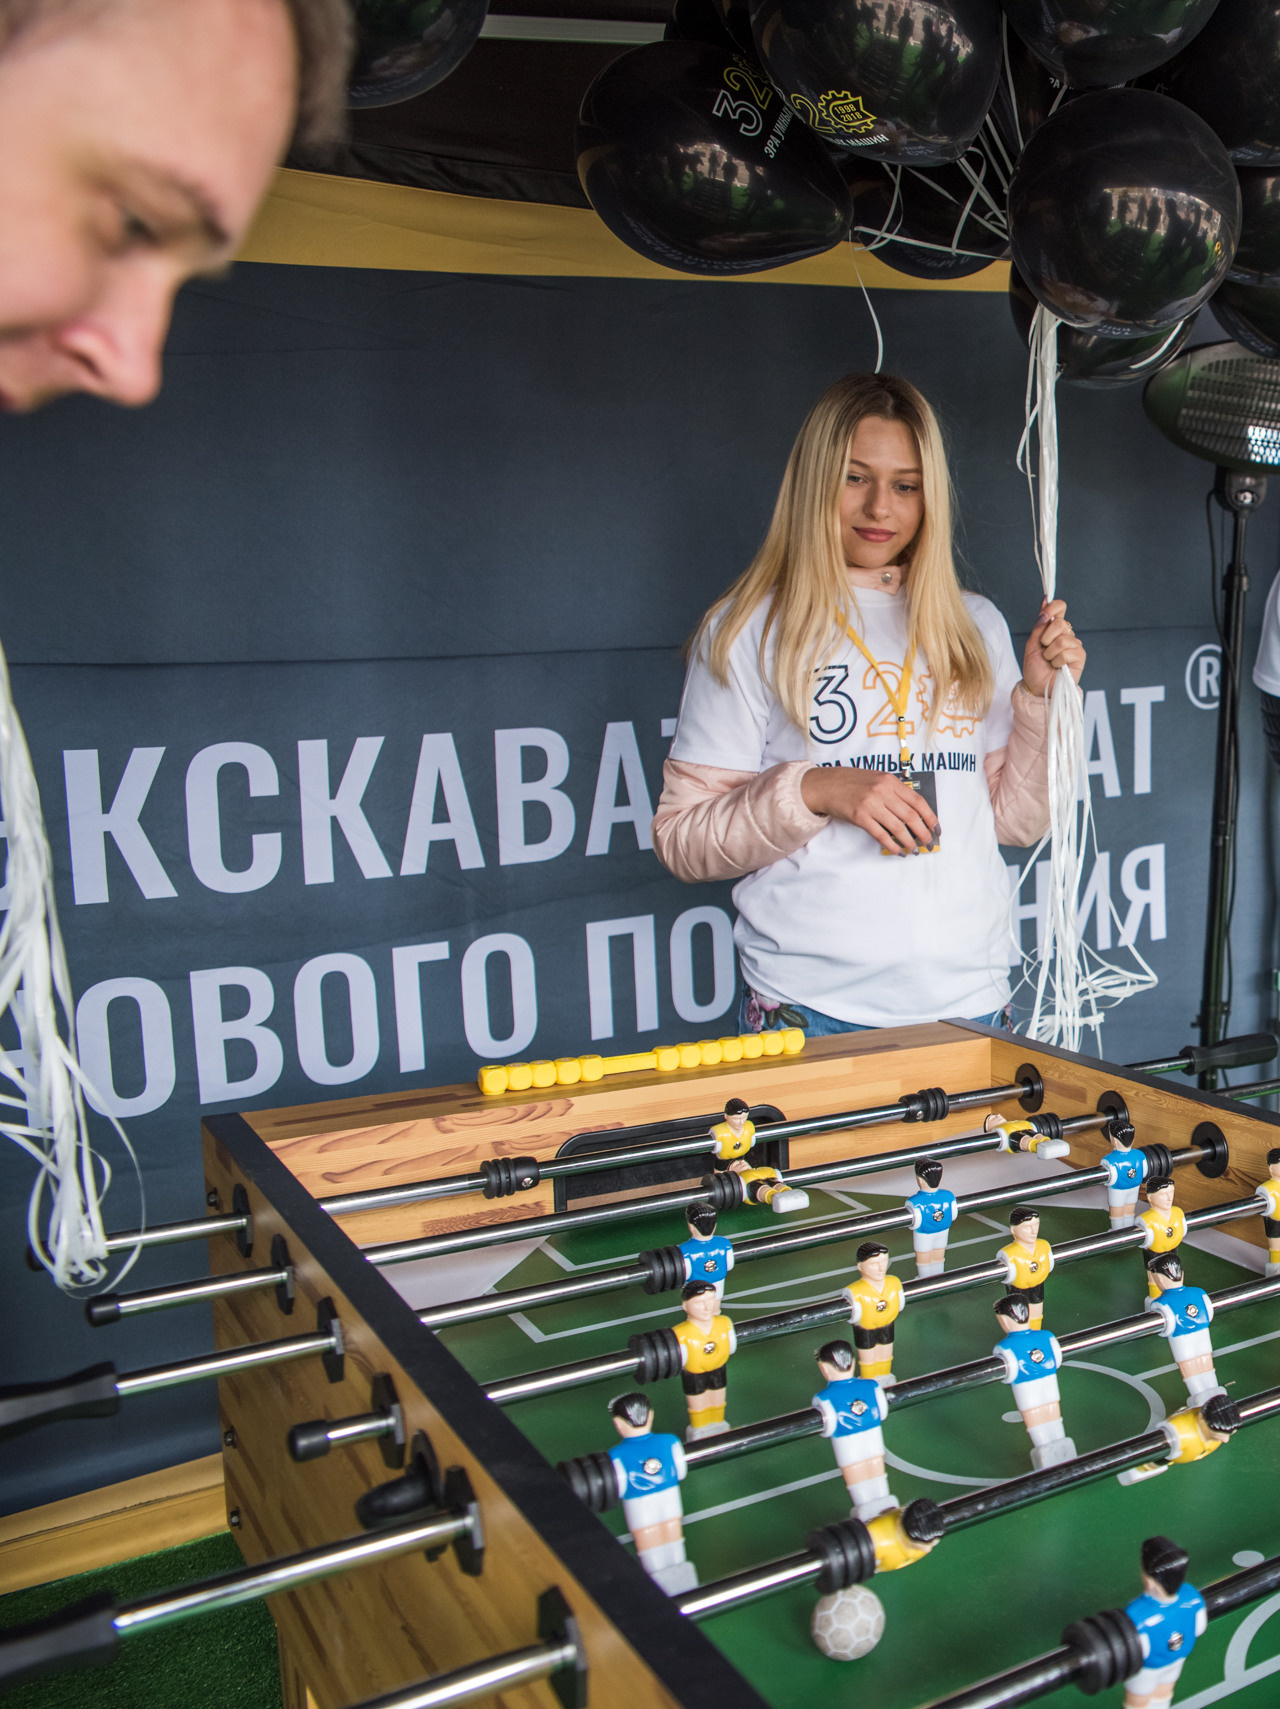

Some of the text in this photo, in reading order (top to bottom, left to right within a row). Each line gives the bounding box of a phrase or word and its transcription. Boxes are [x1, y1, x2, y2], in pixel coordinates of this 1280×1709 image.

[834, 103, 857, 115] 1998
[840, 111, 863, 123] 2018
[764, 134, 781, 159] ЭРА
[921, 751, 977, 772] МАШИН
[0, 717, 678, 906] КСКАВА
